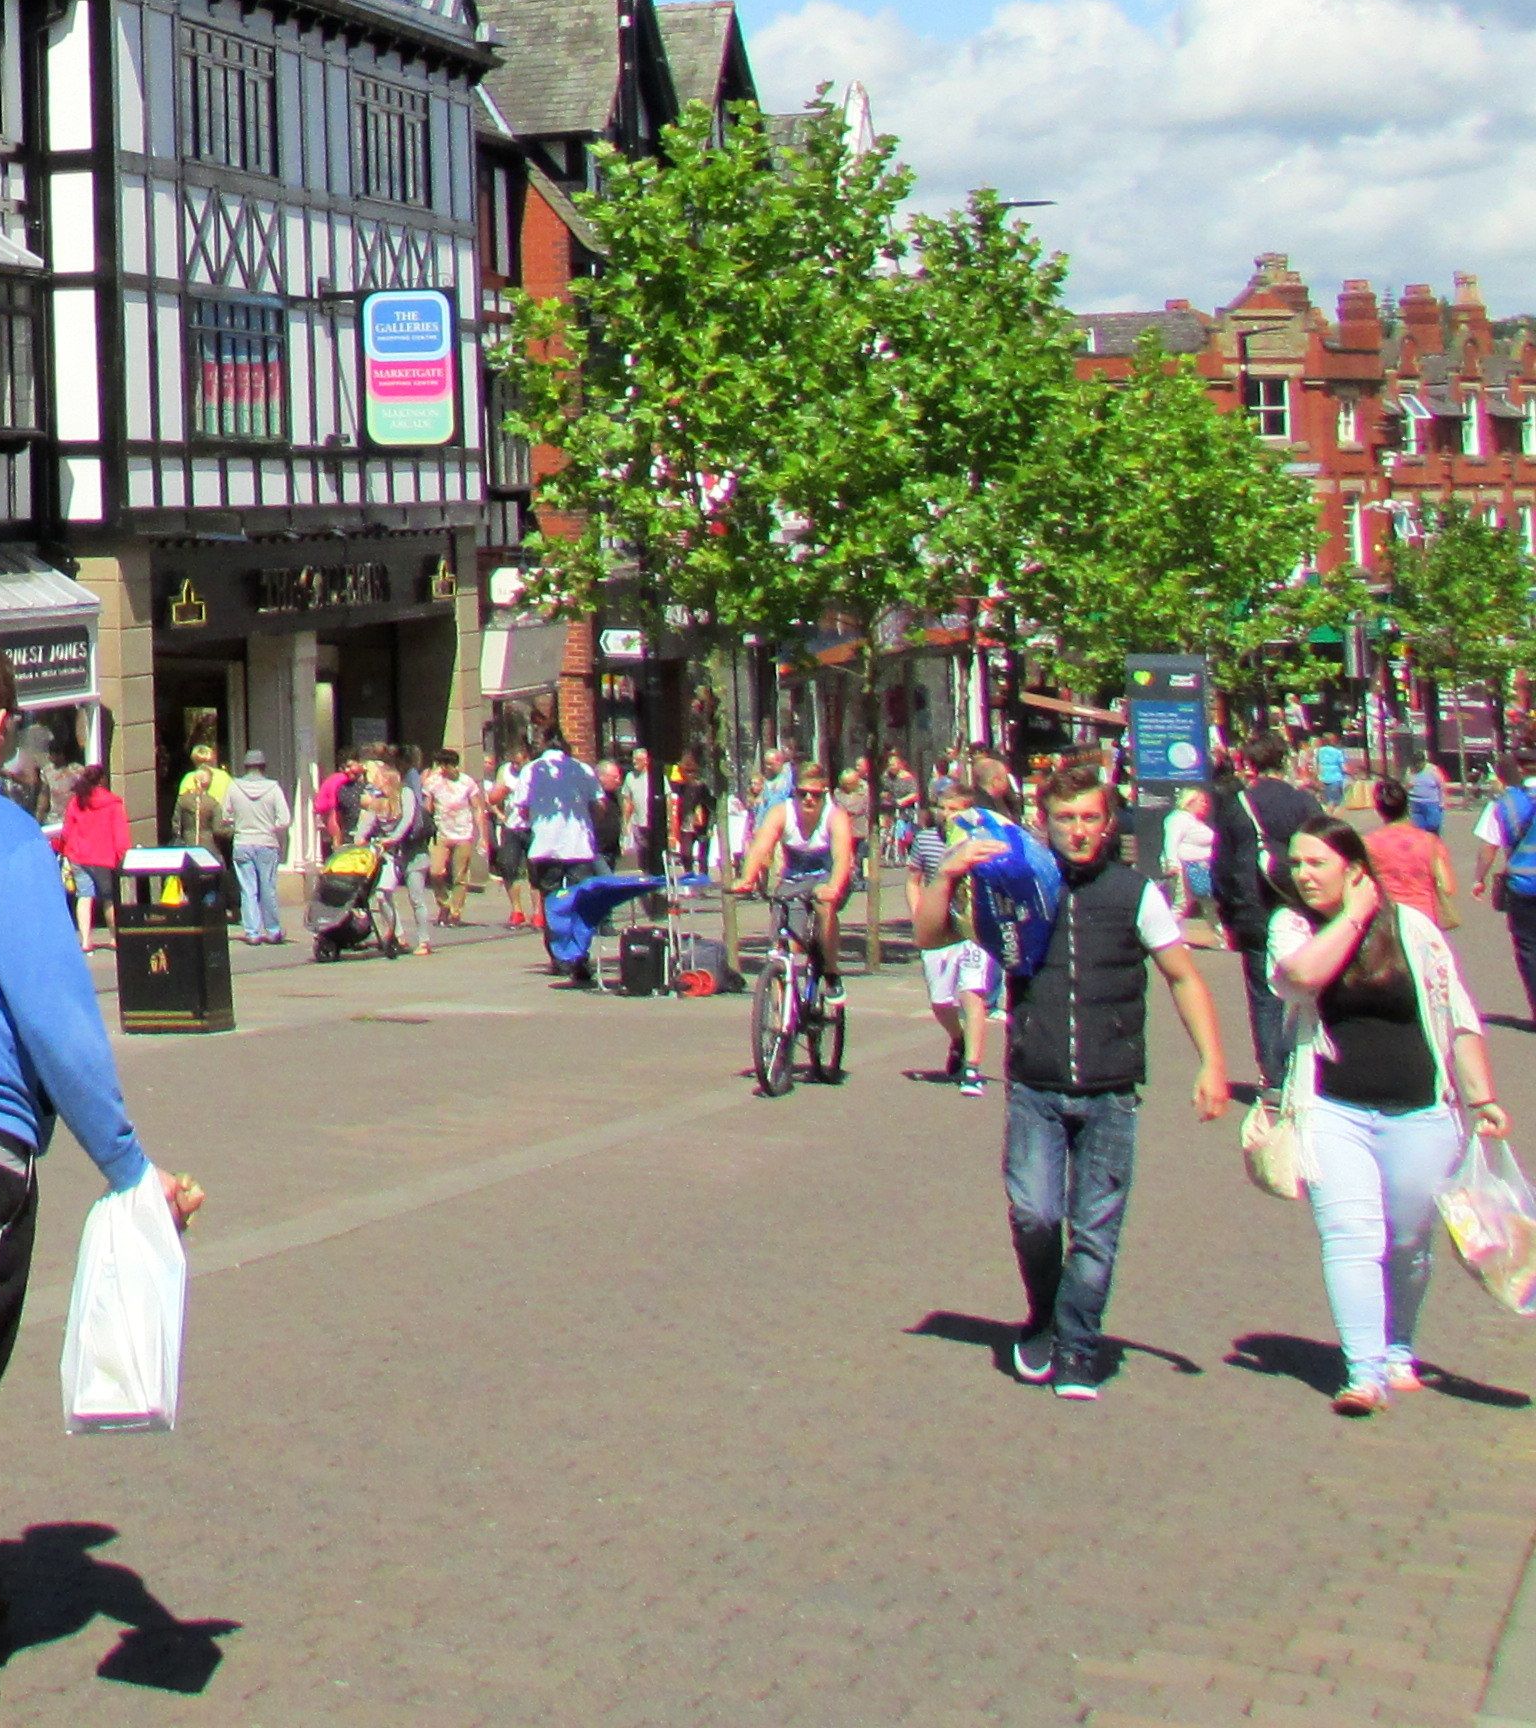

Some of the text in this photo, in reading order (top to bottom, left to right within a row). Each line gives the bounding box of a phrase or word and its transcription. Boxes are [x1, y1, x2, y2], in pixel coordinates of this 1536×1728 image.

[394, 310, 420, 321] THE
[375, 321, 440, 333] GALLERIES
[373, 368, 444, 379] MARKETGATE
[5, 640, 88, 666] RNEST JONES
